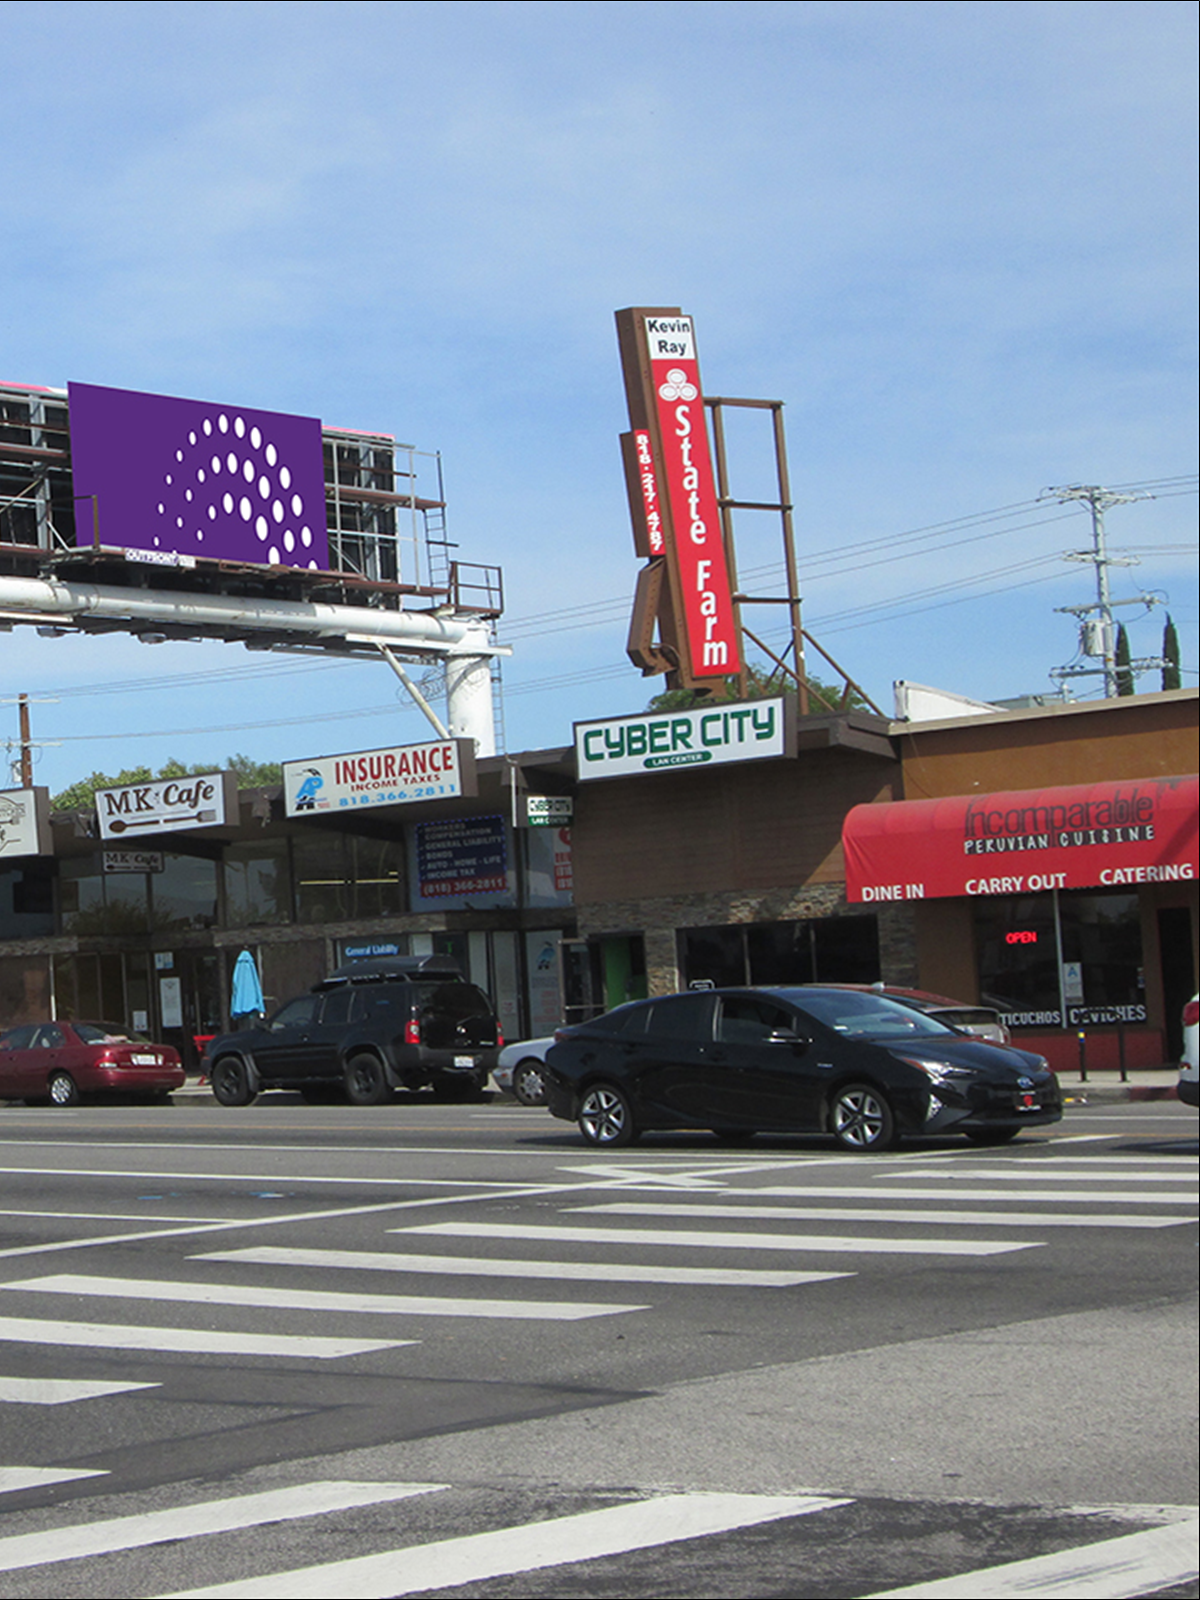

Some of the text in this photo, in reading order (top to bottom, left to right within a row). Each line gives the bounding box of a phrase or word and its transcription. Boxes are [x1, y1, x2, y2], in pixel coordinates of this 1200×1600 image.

[647, 319, 691, 333] Kevin
[658, 340, 687, 356] Ray
[675, 405, 728, 667] State Farm
[583, 706, 775, 762] CYBER CITY
[335, 746, 454, 785] INSURANCE
[652, 753, 703, 766] LAN CENTER
[351, 773, 441, 792] INCOME TAXES
[104, 780, 215, 816] MK Cafe
[339, 784, 456, 807] 818.366.2811
[964, 788, 1154, 847] Incomparable
[425, 835, 502, 850] GENERAL LIABILITY
[963, 825, 1155, 855] PERUVIAN CUISINE
[105, 853, 159, 866] MK Cafe
[426, 851, 453, 860] BONDS
[426, 855, 502, 870] AUTO HOME LIFE
[426, 868, 476, 879] INCOME TAX
[1099, 863, 1194, 886] CATERING
[423, 878, 503, 896] (818) 366-2811
[861, 884, 925, 901] DINE IN
[965, 873, 1067, 895] CARRY OUT
[1005, 931, 1038, 944] OPEN
[1066, 966, 1078, 977] A
